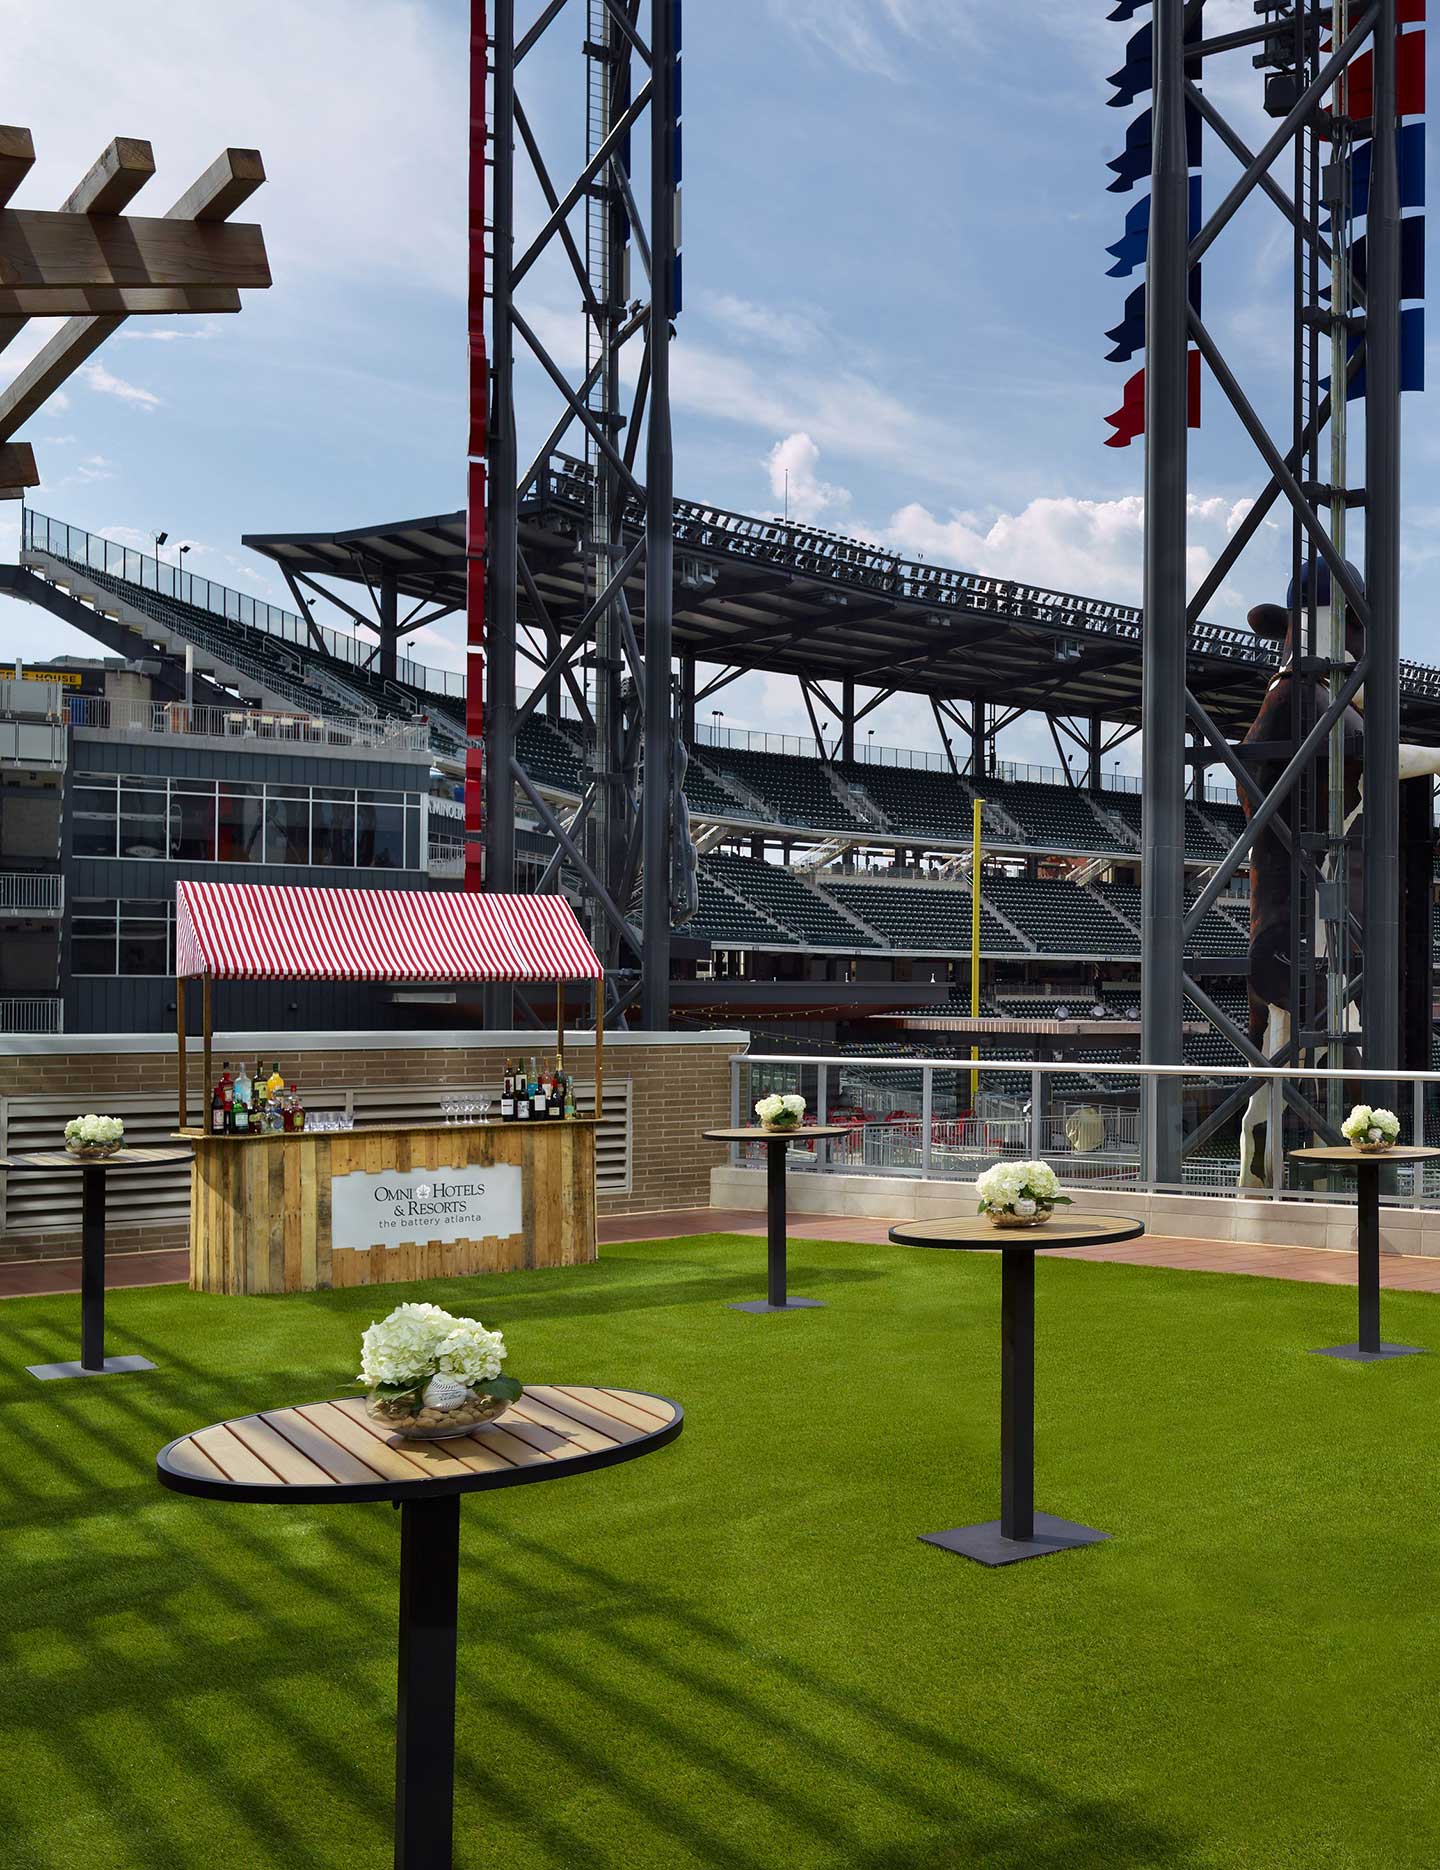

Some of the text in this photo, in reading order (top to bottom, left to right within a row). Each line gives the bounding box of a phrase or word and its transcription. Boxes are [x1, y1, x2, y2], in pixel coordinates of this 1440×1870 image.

[374, 1183, 485, 1202] OMNI HOTELS
[393, 1201, 467, 1217] & RESORTS
[379, 1214, 482, 1228] the battery atlanta
